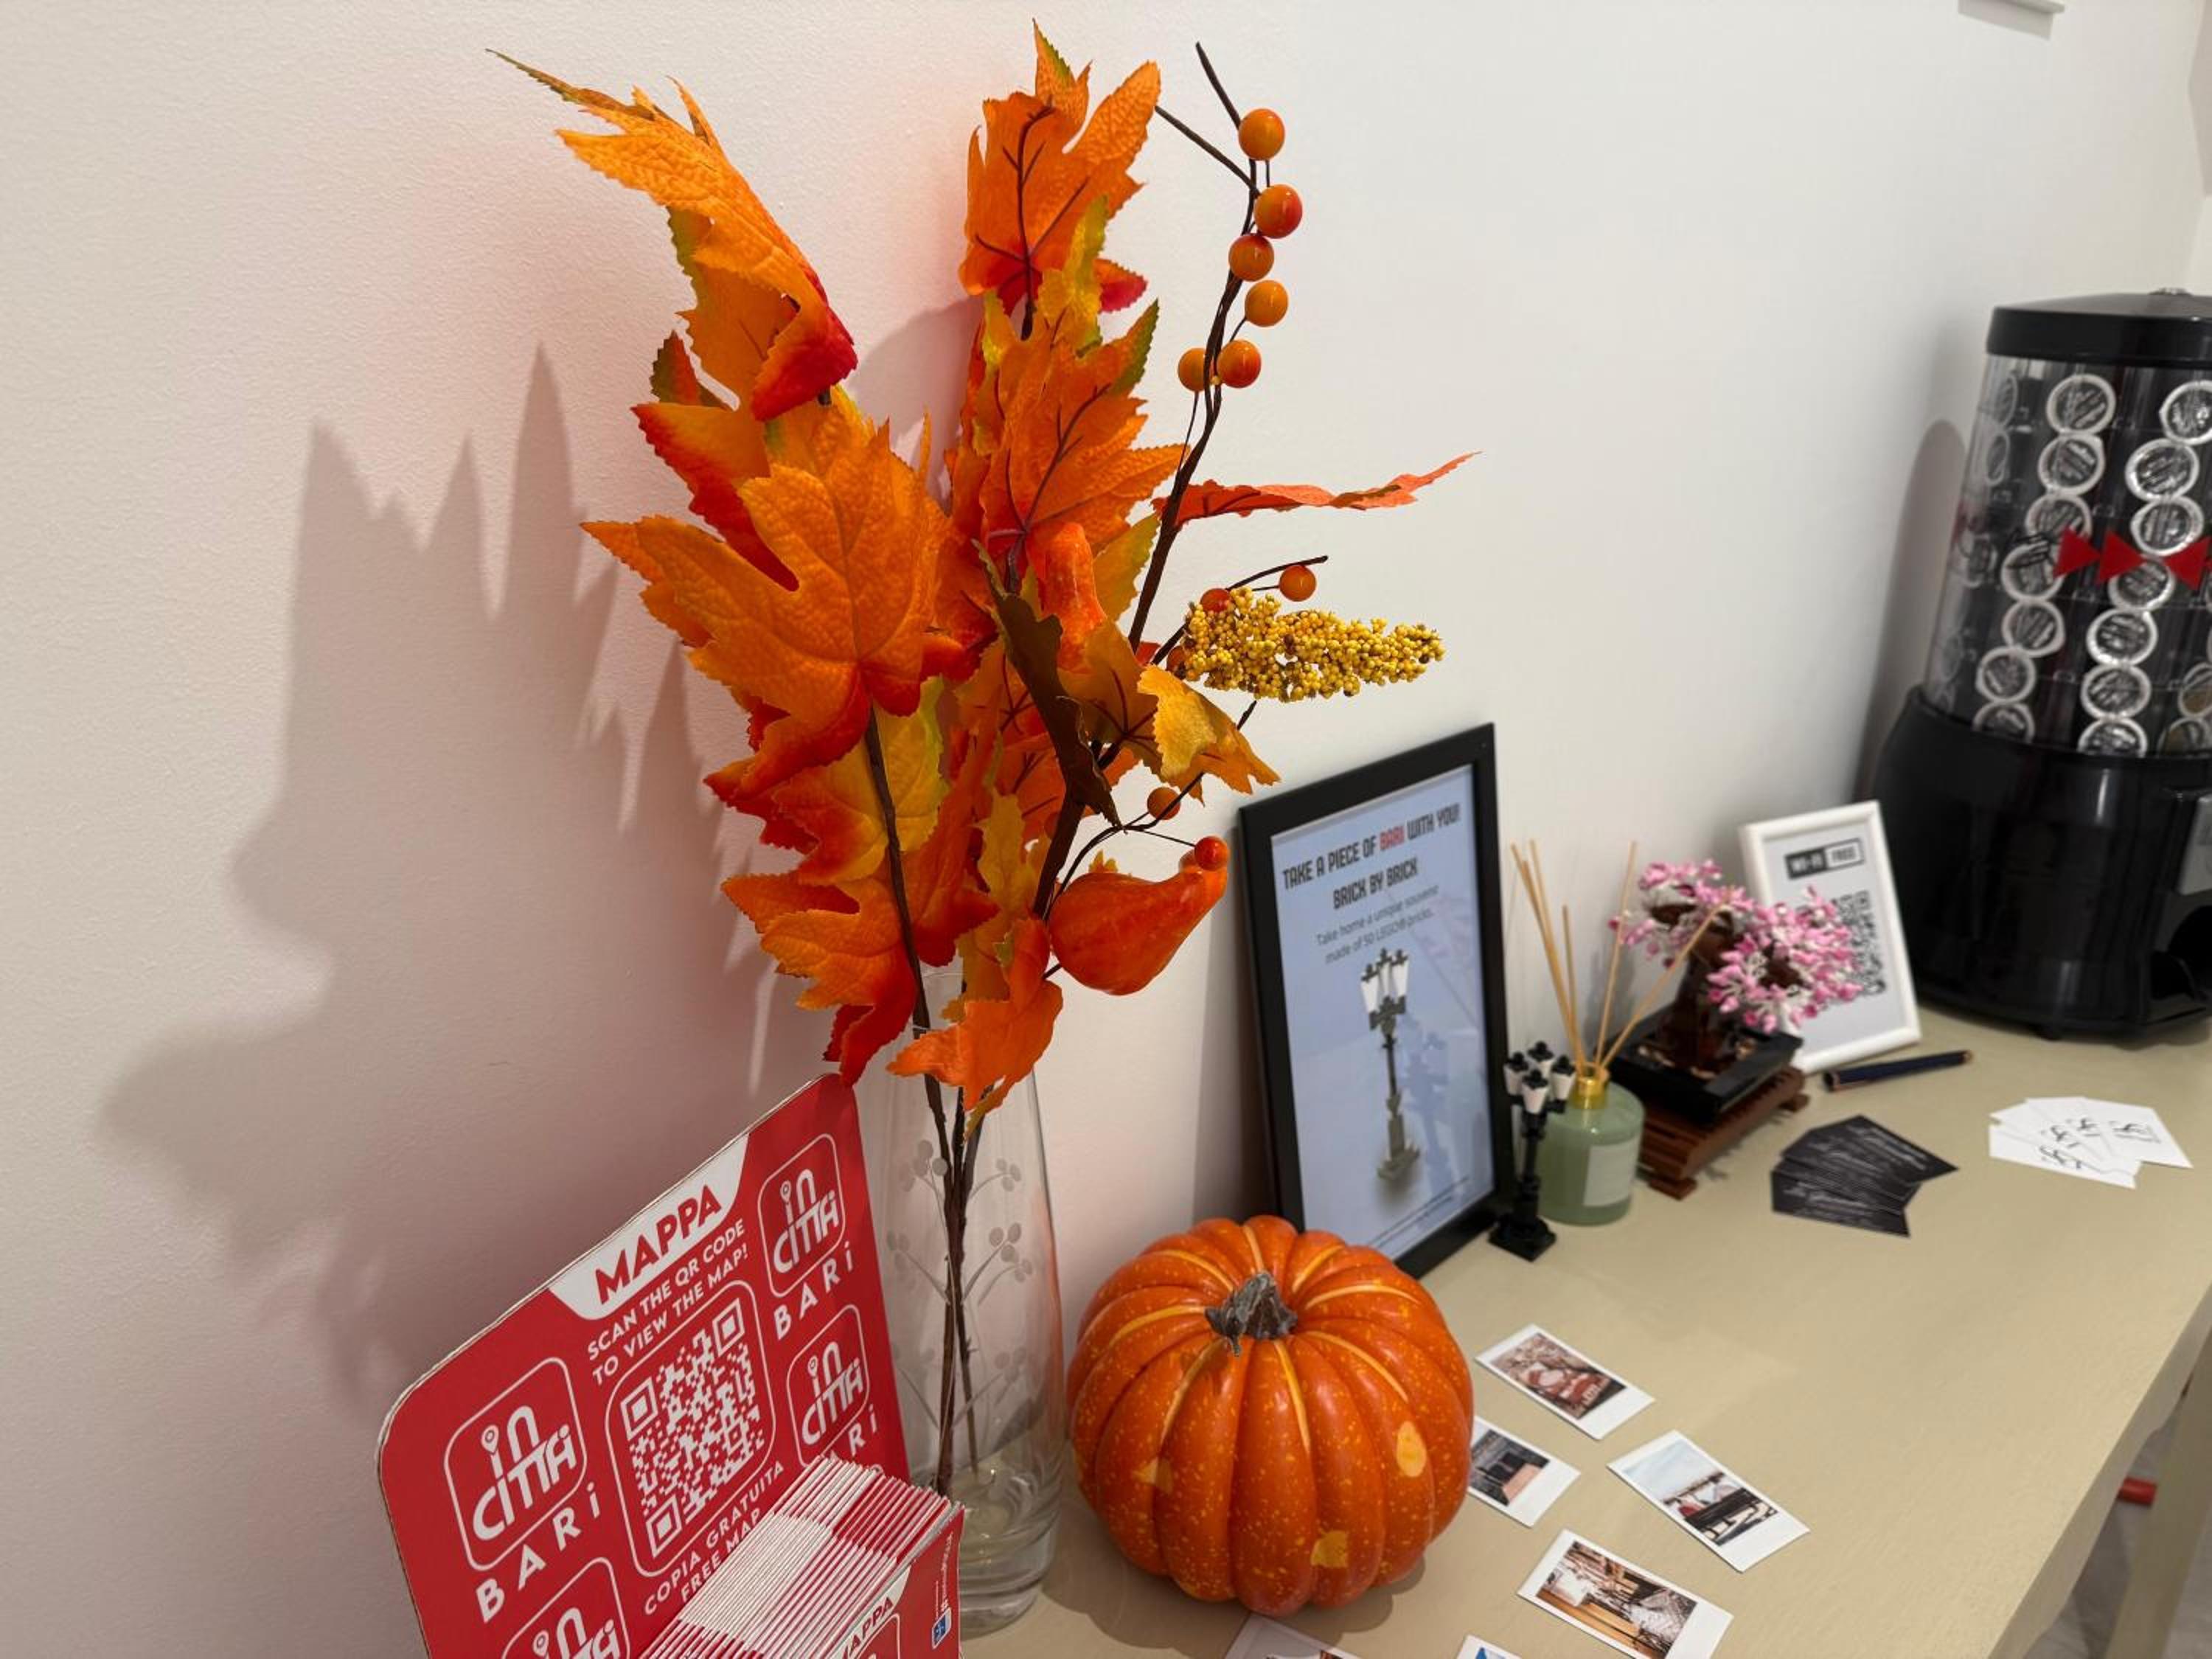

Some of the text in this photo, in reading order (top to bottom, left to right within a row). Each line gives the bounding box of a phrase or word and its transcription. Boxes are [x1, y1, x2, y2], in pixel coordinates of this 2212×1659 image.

[1282, 860, 1312, 890] TAKE
[1316, 856, 1326, 877] A
[1328, 841, 1360, 873] PIECE
[1363, 835, 1377, 858] OF
[1407, 813, 1435, 841] WITH
[1333, 857, 1418, 910] BRICK BY BRICK
[588, 1218, 745, 1361] SCAN THE QR CODE
[595, 1185, 722, 1305] MAPPA
[592, 1243, 748, 1385] TO VIEW THE MAP!
[644, 1461, 785, 1615] COPIA GRATUITA
[681, 1508, 760, 1603] FREE MAP
